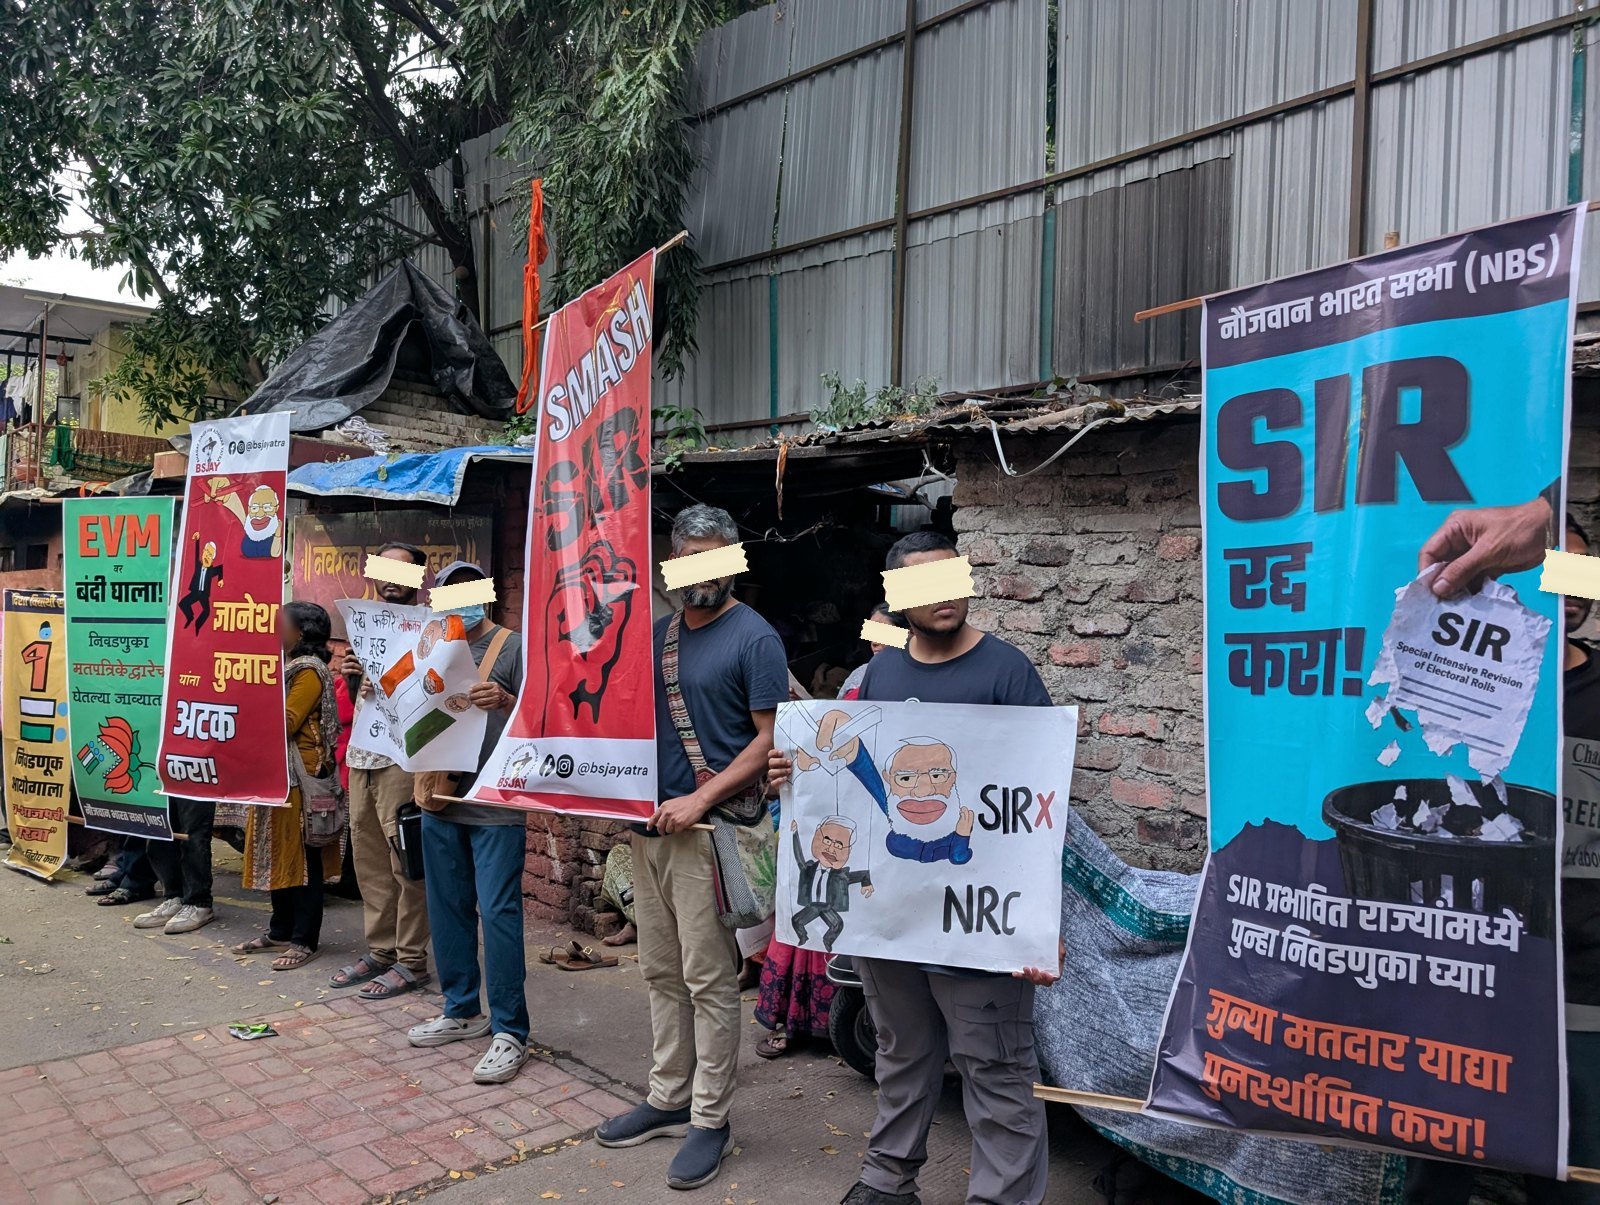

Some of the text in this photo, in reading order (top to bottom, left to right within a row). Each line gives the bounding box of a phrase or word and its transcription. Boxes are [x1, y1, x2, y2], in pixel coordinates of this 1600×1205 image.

[1218, 233, 1560, 340] नौजवान भारत सभा (NBS)
[545, 279, 652, 442] SMASH
[1216, 355, 1477, 522] SIR
[195, 462, 221, 473] BSJAY
[541, 406, 649, 552] SIR
[78, 514, 160, 557] EVM
[75, 575, 163, 603] बंदी घाला!
[113, 564, 123, 574] वर
[1224, 541, 1312, 612] रद्द
[213, 593, 279, 634] ज्ञानेश
[1432, 612, 1511, 663] SIR
[88, 631, 149, 654] निवडणुका
[1224, 627, 1365, 697] करा!
[1396, 641, 1523, 689] Special Intensive Revision
[179, 670, 201, 687] यांना
[212, 652, 279, 693] कुमार
[1414, 660, 1496, 693] of Electoral Rolls
[172, 700, 239, 742] अटक
[165, 753, 219, 785] करा!
[496, 777, 528, 789] BSJAY
[577, 762, 648, 777] @bsjayatra
[978, 784, 1033, 834] SIR
[943, 884, 1021, 935] NRC
[1226, 874, 1523, 952] SIR प्रभावित राज्यांमध्ये
[1227, 918, 1496, 998] पुन्हा निवडणुका घ्या!
[1205, 988, 1514, 1094] जुन्या मतदार याद्या
[1199, 1051, 1486, 1160] पुनर्स्थापित करा!
